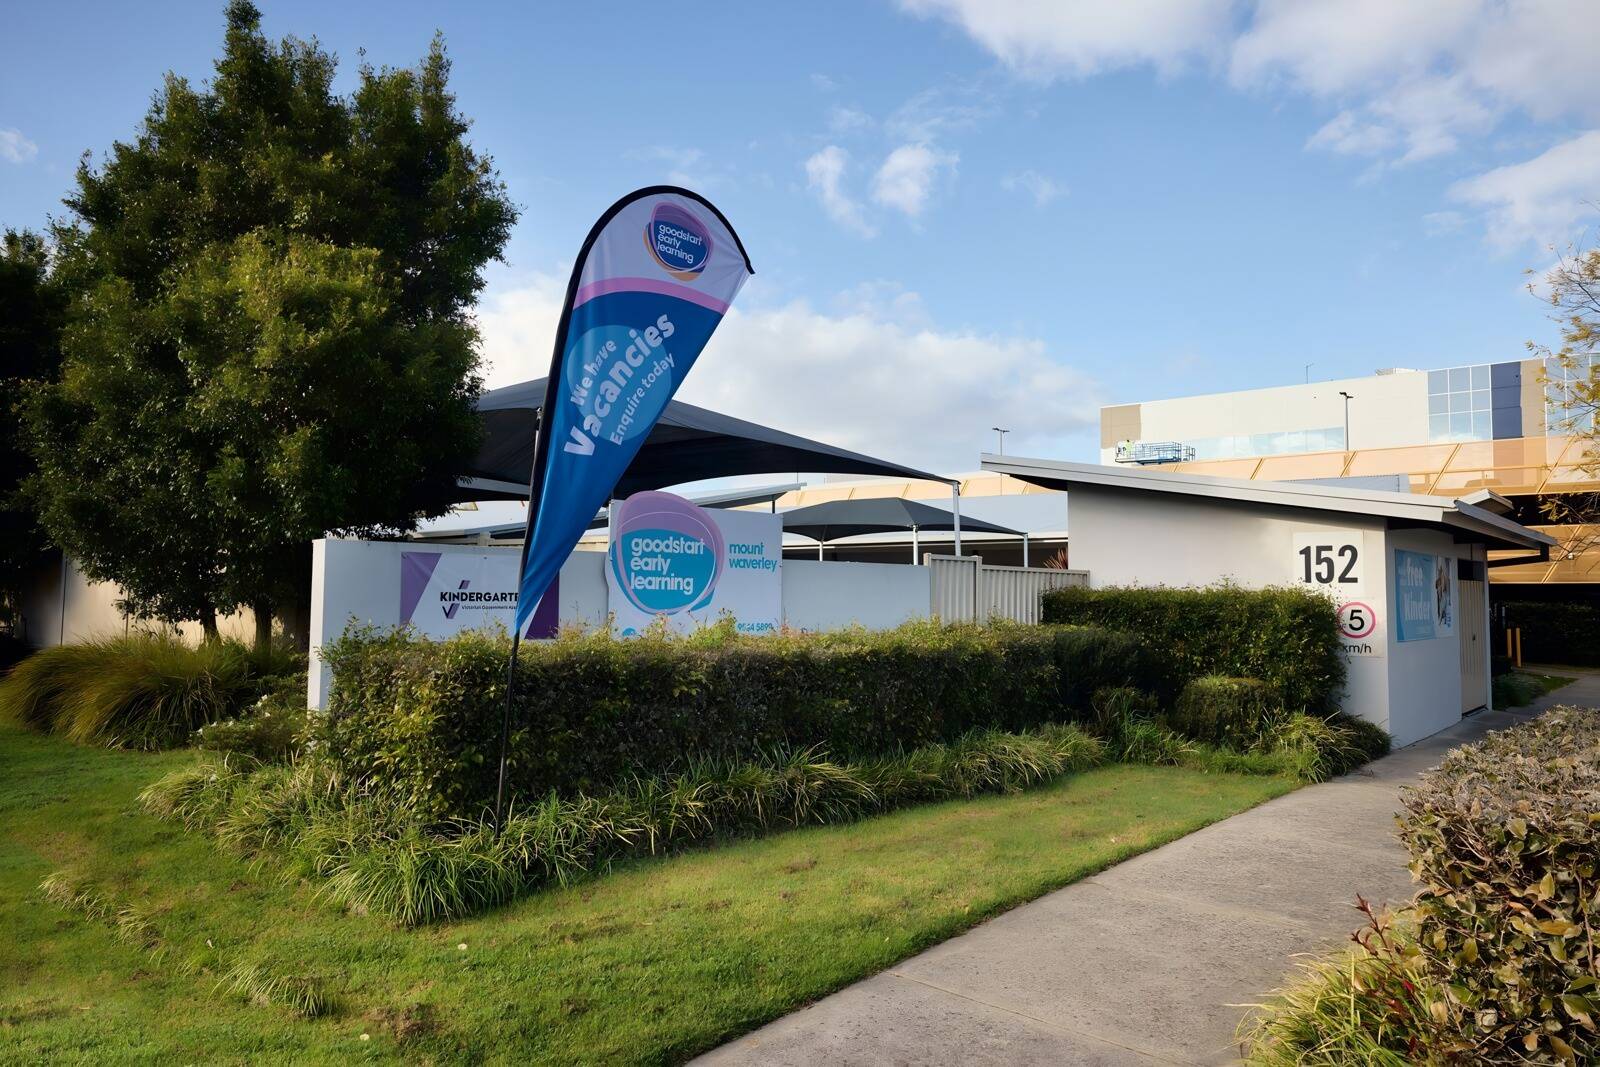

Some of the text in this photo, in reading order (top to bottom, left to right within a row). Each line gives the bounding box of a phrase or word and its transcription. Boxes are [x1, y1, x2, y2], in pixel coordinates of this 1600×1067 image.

[657, 234, 681, 249] early
[659, 225, 702, 246] goodstart
[657, 241, 694, 264] learning
[570, 340, 617, 406] We have
[563, 314, 675, 456] Vacancies
[609, 353, 675, 445] Enquire today
[631, 536, 705, 556] goodstart
[729, 542, 765, 555] mount
[630, 555, 671, 575] early
[729, 557, 778, 572] waverley
[1298, 544, 1359, 583] 152
[630, 572, 694, 595] learning
[1348, 609, 1365, 631] 5
